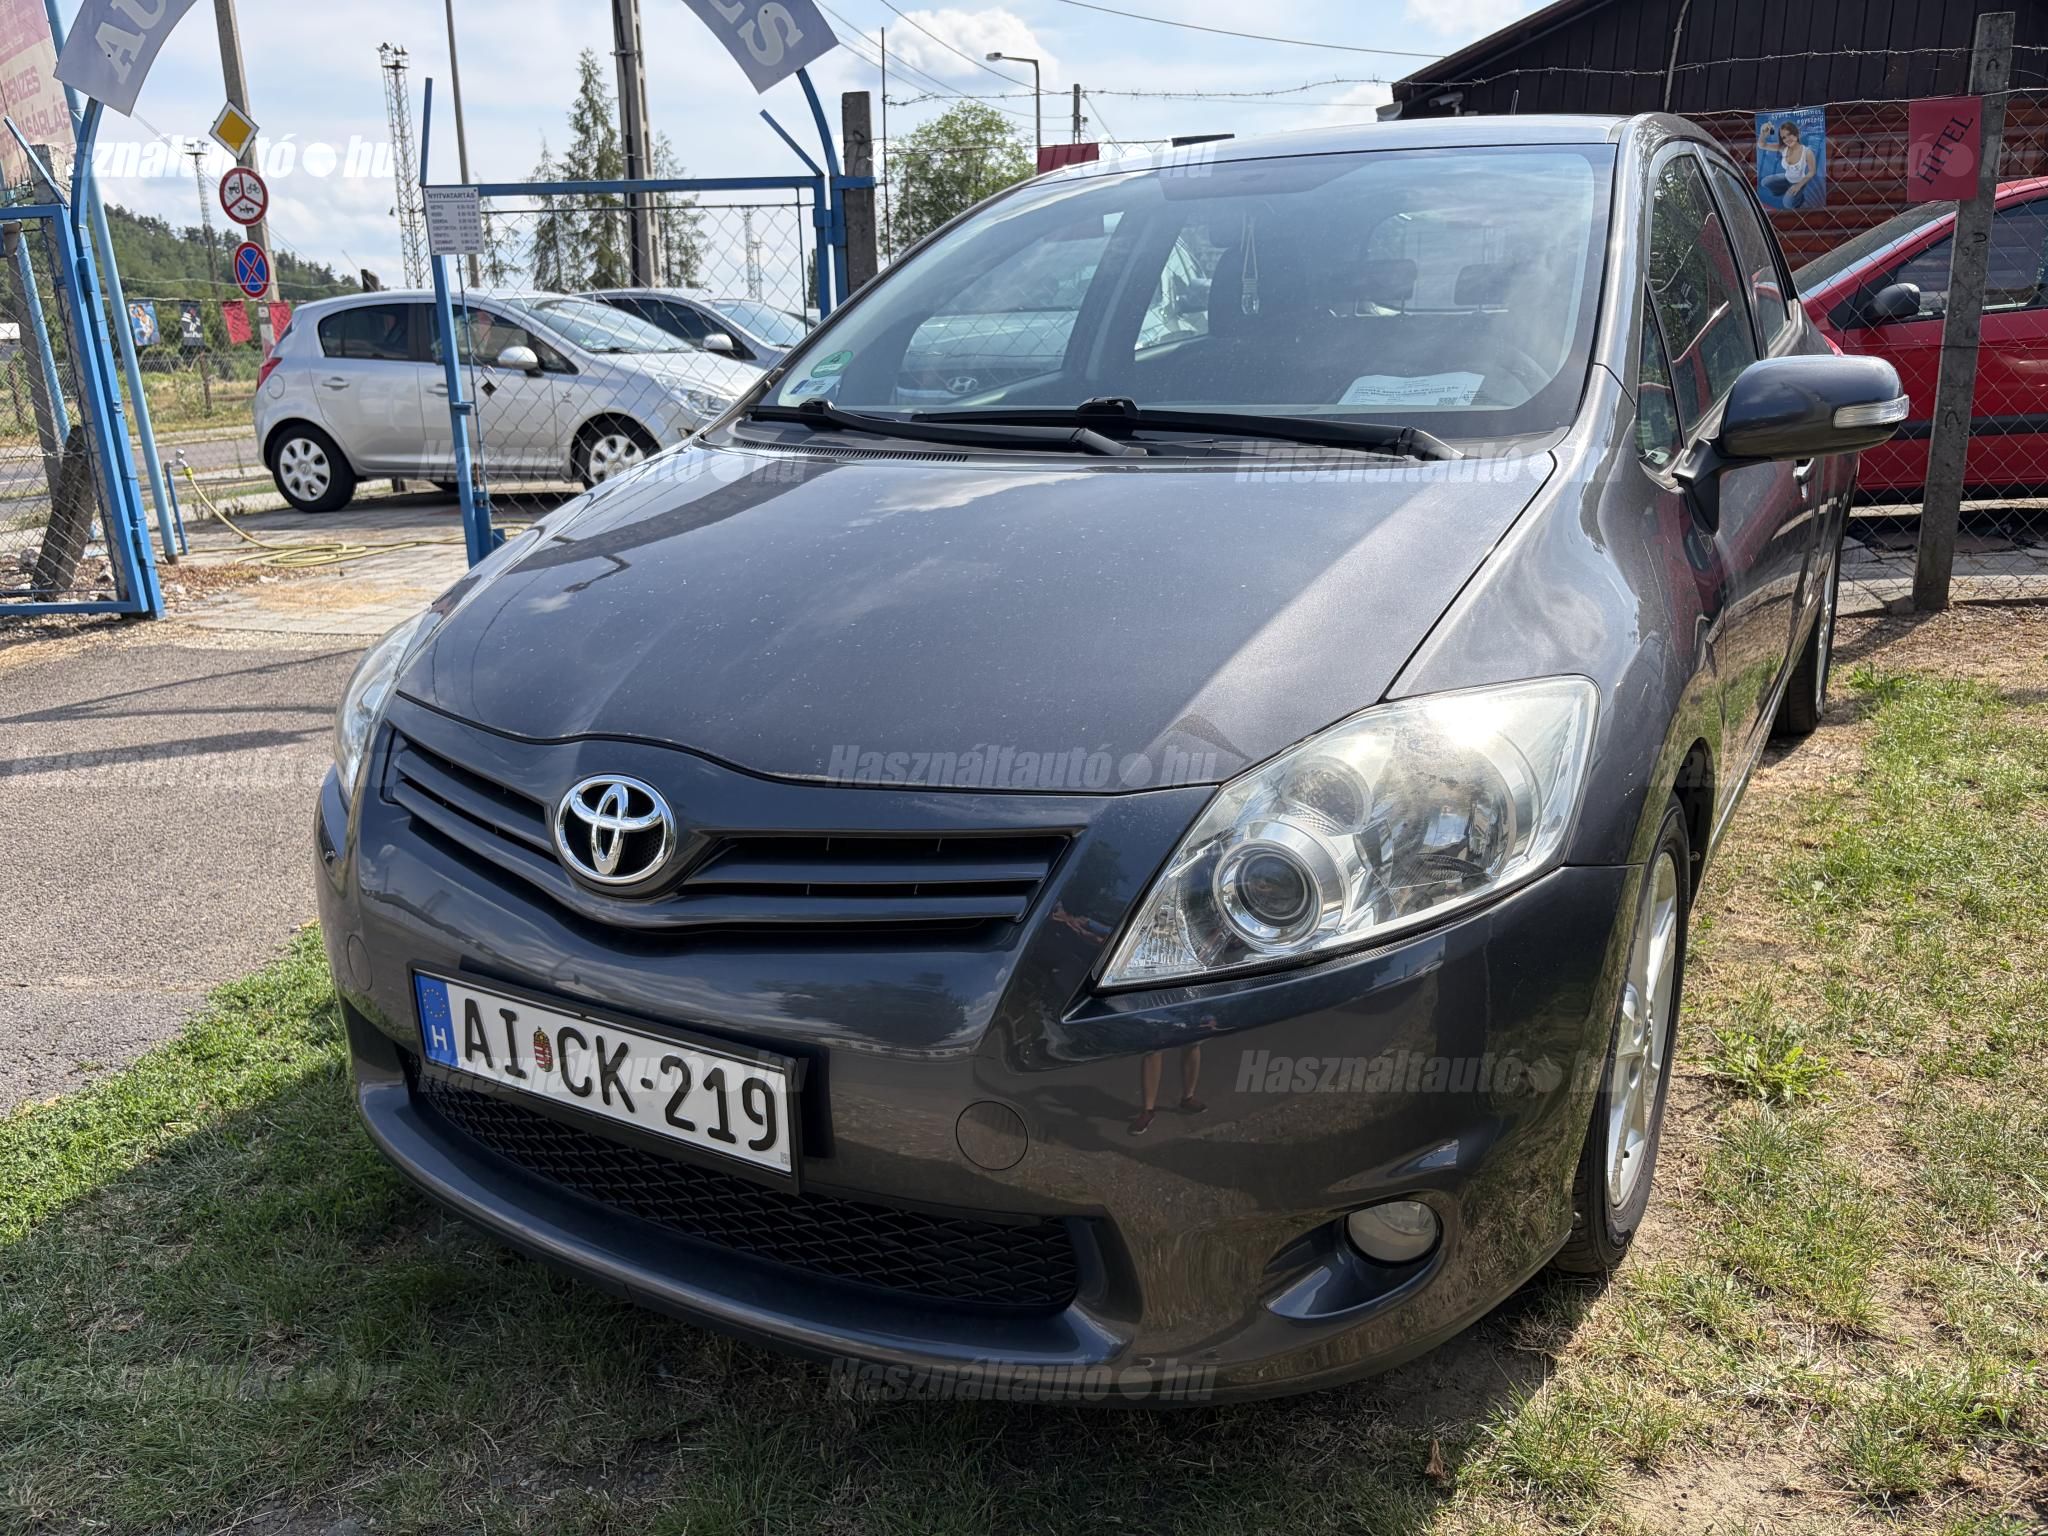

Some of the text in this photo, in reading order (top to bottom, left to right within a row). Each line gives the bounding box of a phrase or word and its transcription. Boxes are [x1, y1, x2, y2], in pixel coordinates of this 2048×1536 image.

[1916, 116, 1974, 185] HITEL
[431, 1024, 449, 1052] H
[556, 1026, 778, 1152] CK-219
